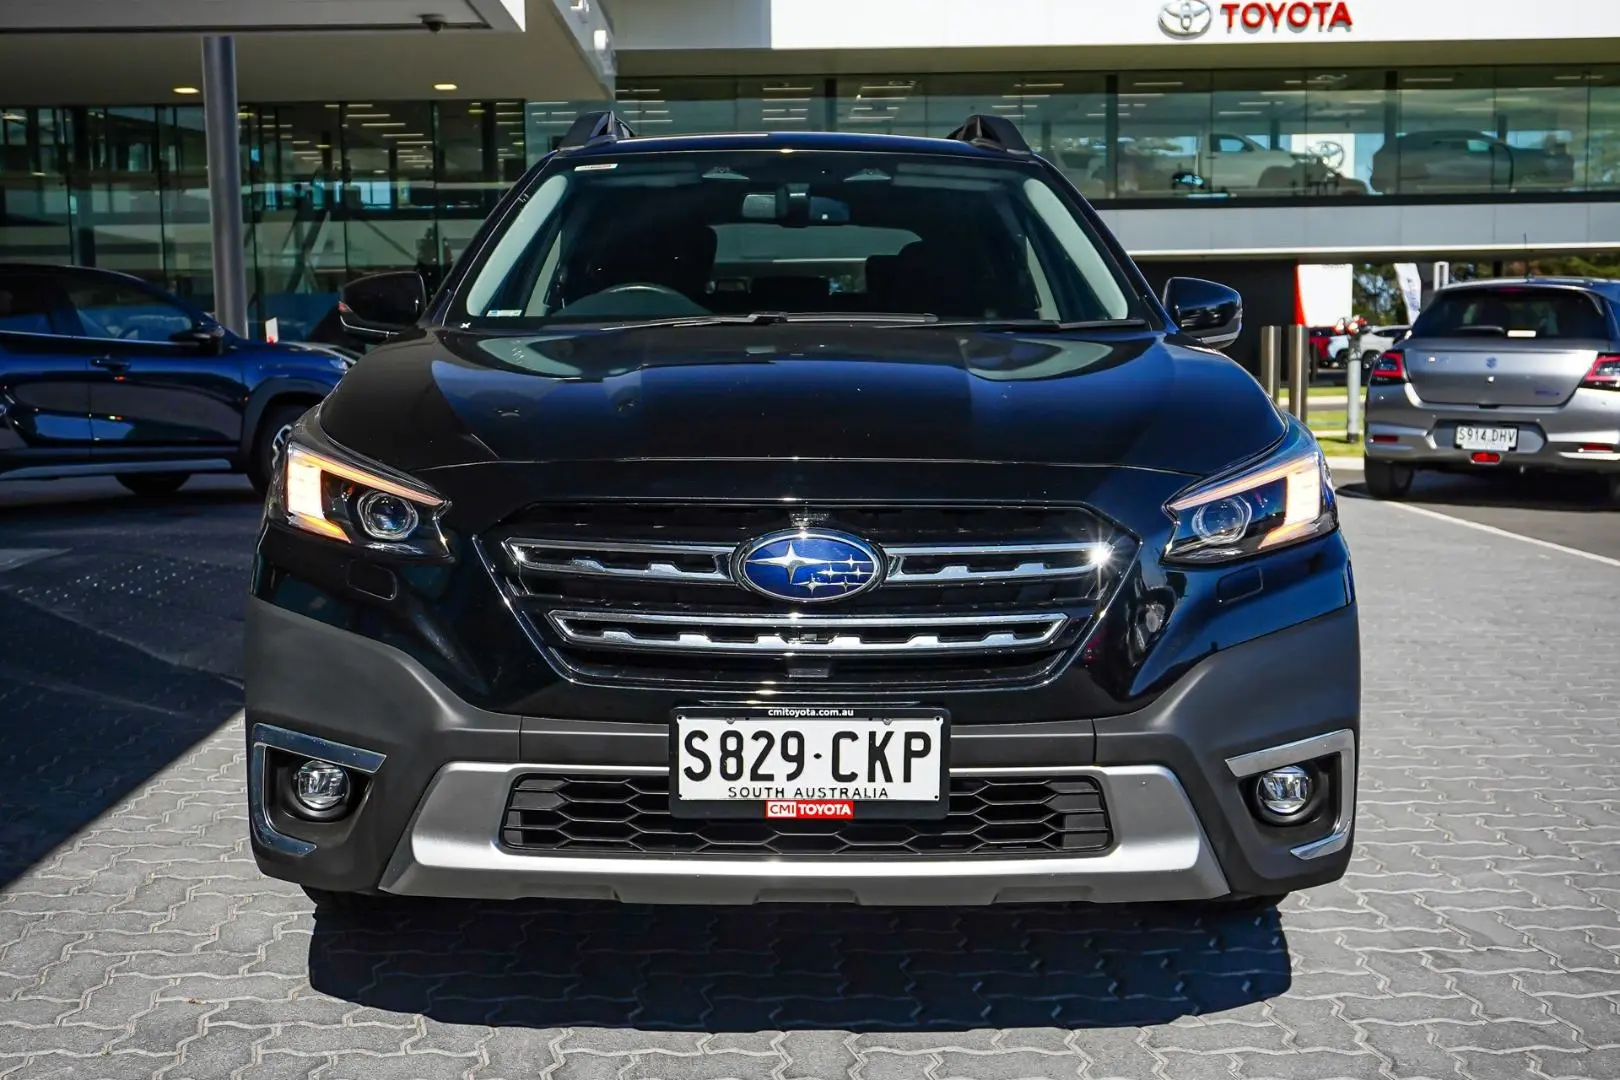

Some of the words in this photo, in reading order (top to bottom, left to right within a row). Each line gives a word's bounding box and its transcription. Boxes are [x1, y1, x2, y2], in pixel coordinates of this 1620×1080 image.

[1220, 2, 1353, 31] TOYOTA
[767, 708, 854, 718] cmitoyota.com.au
[728, 786, 785, 798] SOUTH
[794, 786, 889, 799] AUSTRALIA
[770, 804, 795, 815] CMI
[798, 803, 851, 815] TOYOTA
